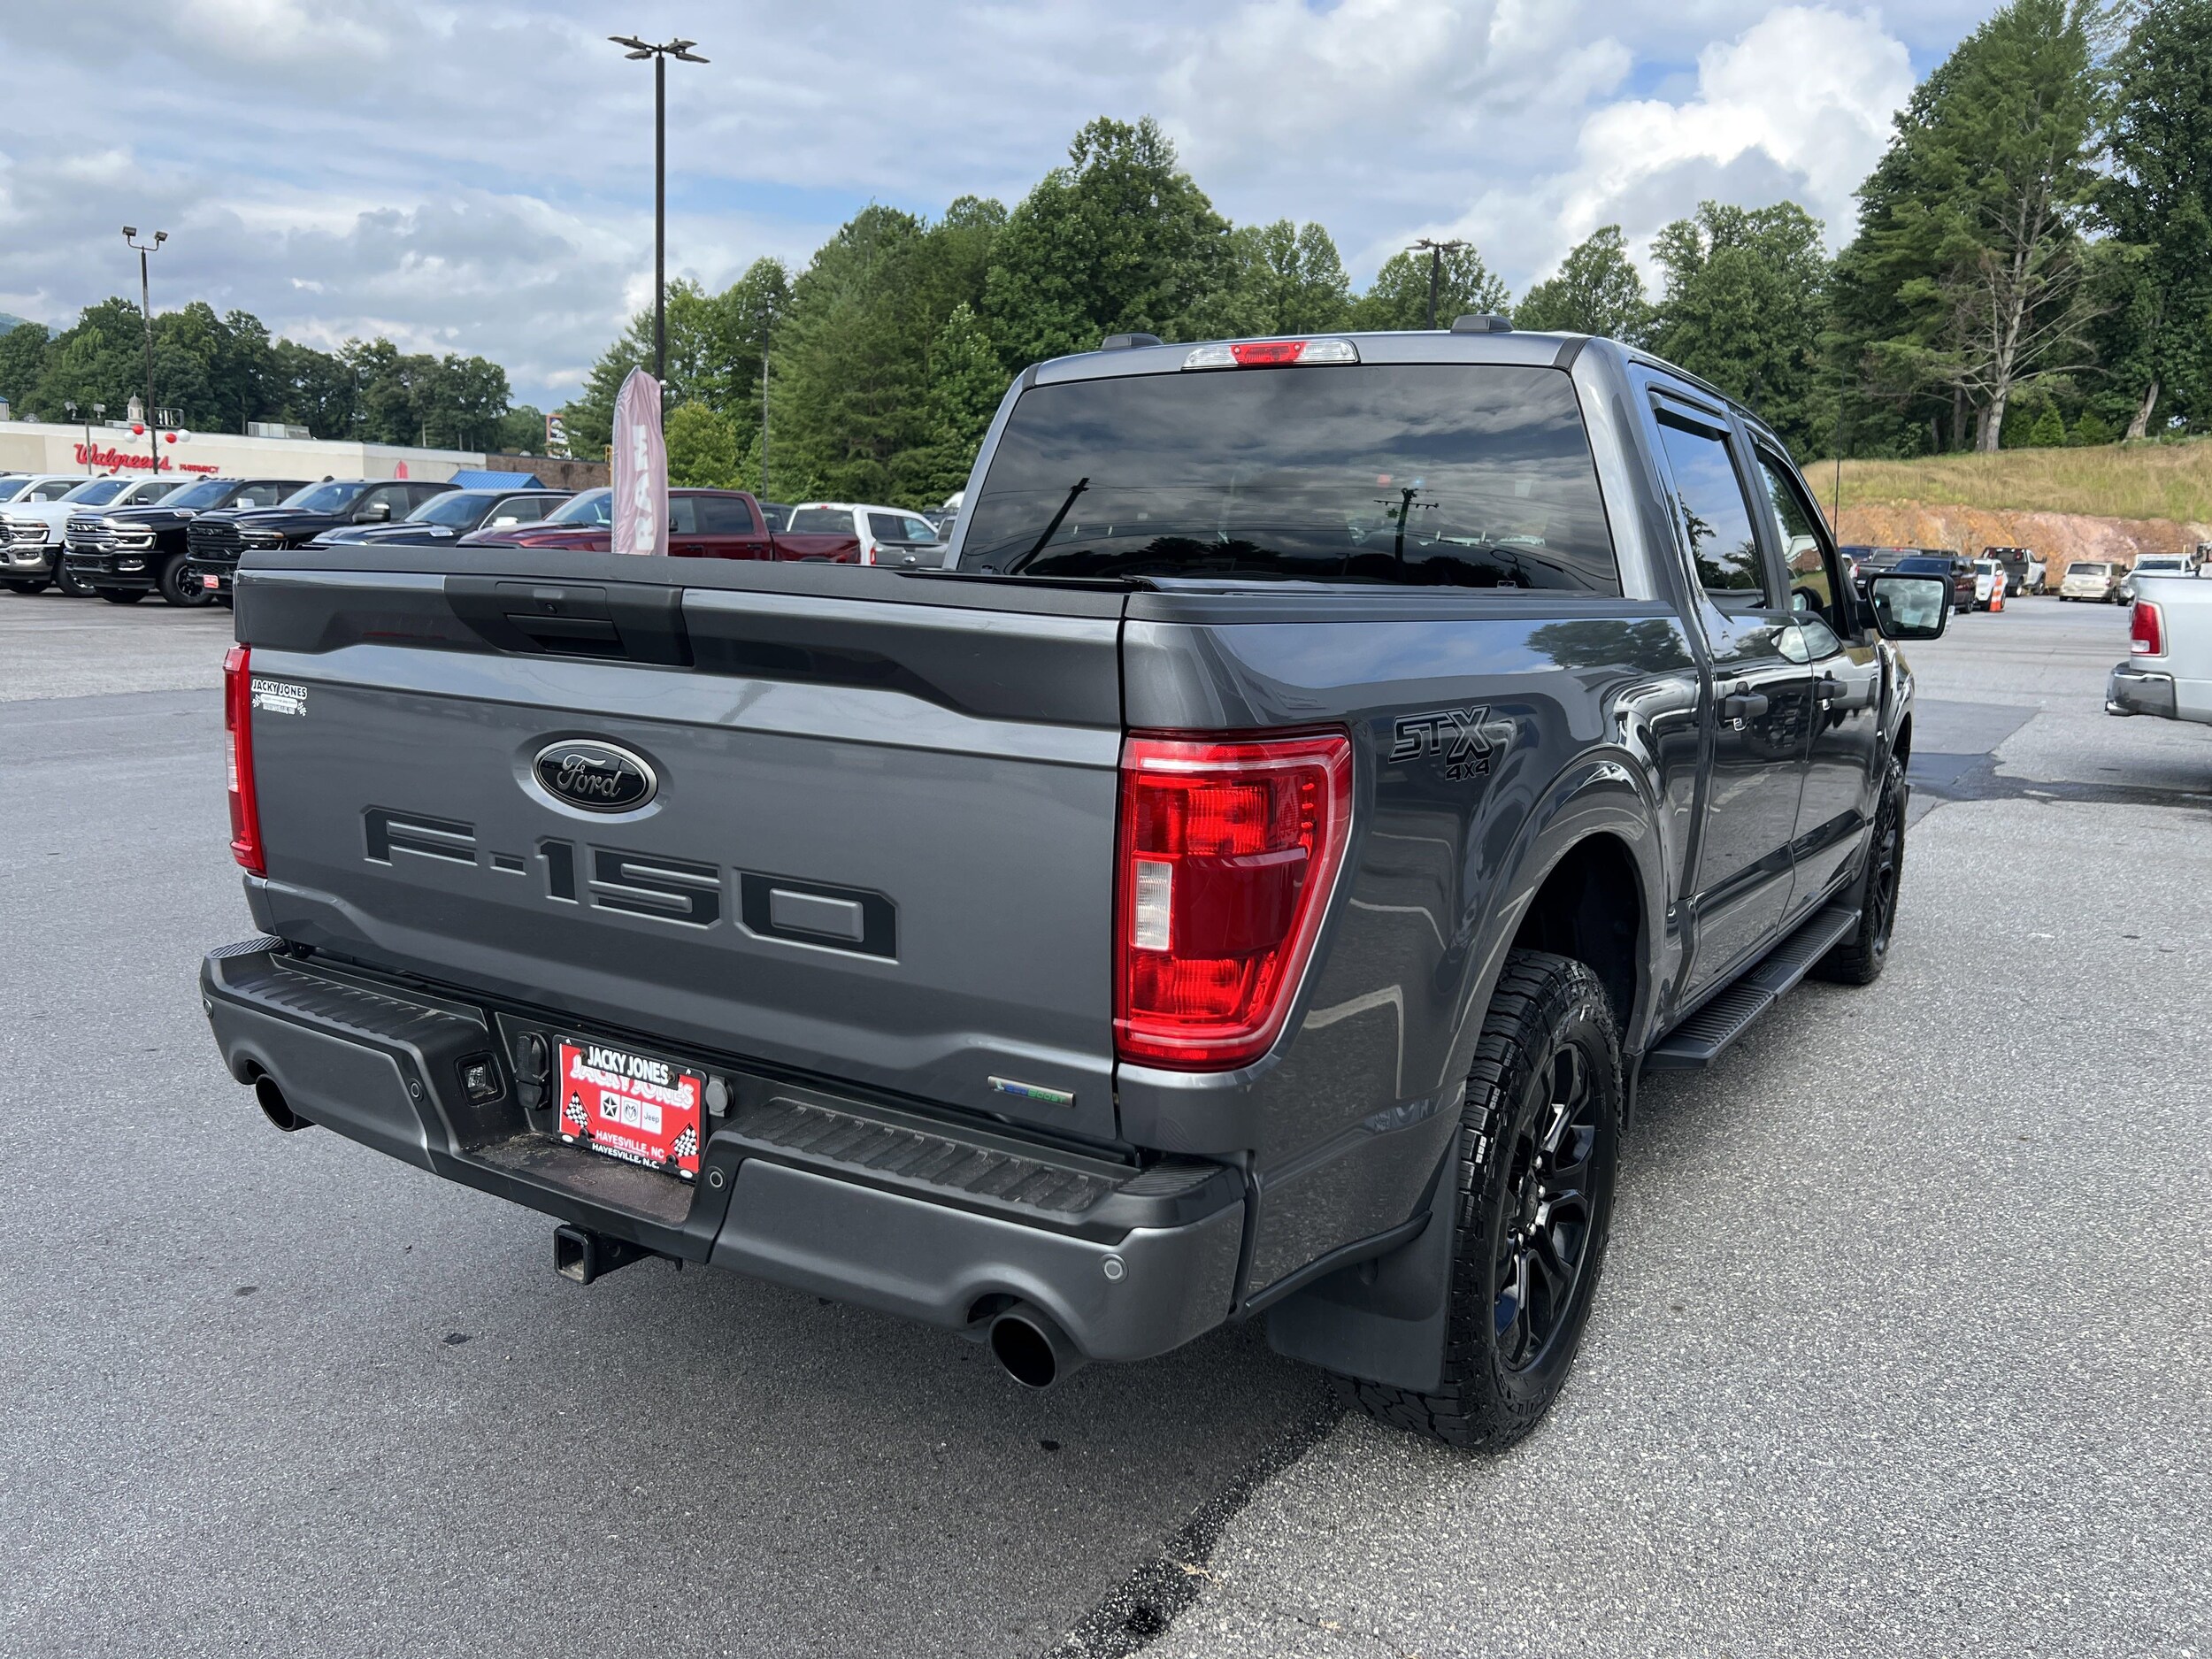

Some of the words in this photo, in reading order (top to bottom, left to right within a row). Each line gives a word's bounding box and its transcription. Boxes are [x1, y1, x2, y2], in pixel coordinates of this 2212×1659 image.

[73, 443, 173, 473] Walgreens
[632, 424, 656, 550] RAM
[252, 679, 279, 695] JACKY
[279, 682, 308, 700] JONES
[1388, 704, 1494, 764] STX
[557, 754, 621, 797] Ford
[359, 804, 899, 964] F-150
[588, 1046, 626, 1073] JACKY
[627, 1056, 669, 1086] JONES
[643, 1112, 660, 1124] Jeep
[595, 1129, 649, 1157] HAYESVILLE,
[651, 1146, 664, 1158] NC
[642, 1157, 660, 1170] N.C.
